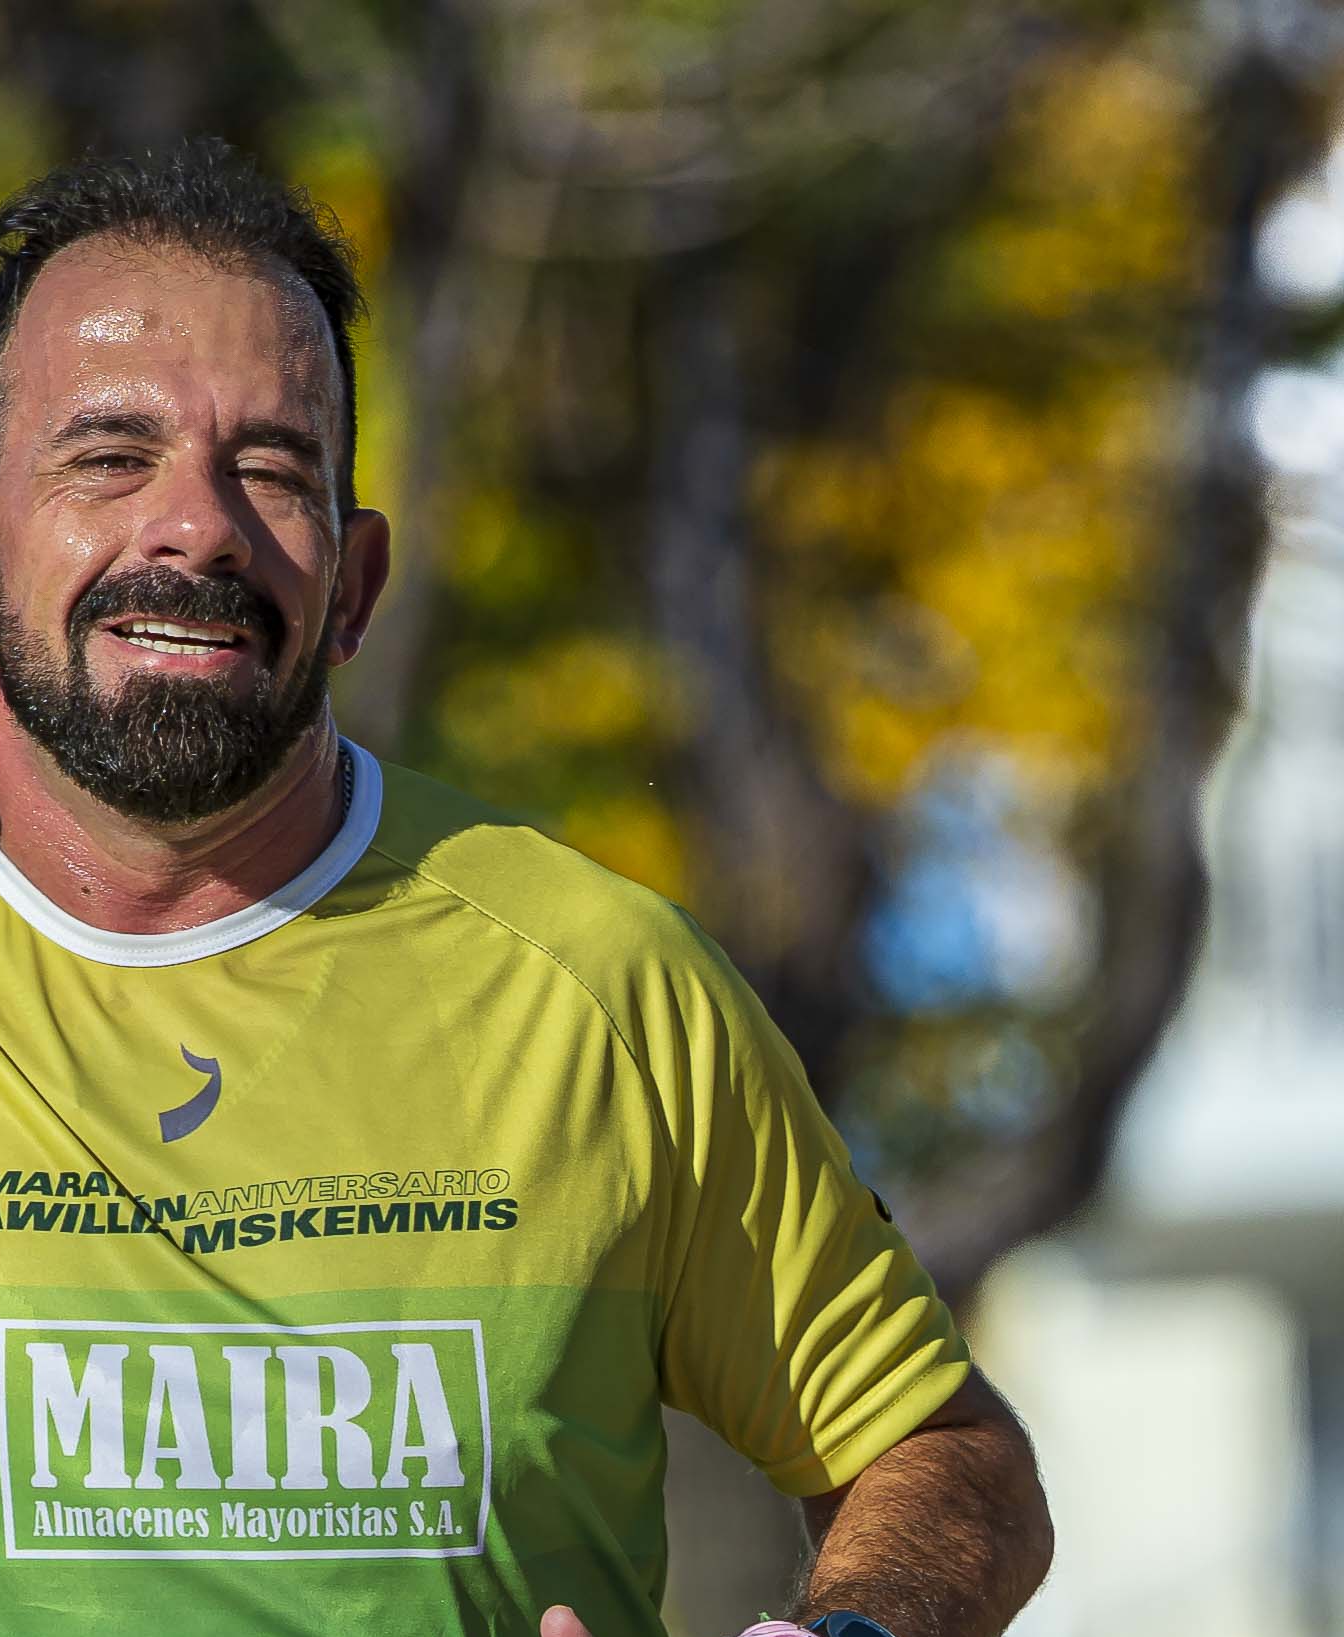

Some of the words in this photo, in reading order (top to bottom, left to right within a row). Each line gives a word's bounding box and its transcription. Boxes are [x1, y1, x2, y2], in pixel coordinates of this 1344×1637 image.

[186, 1168, 510, 1219] ANIVERSARIO
[25, 1343, 465, 1489] MAIRA
[33, 1501, 209, 1538] Almacenes
[220, 1502, 398, 1543] Mayoristas
[409, 1500, 463, 1537] S.A.
